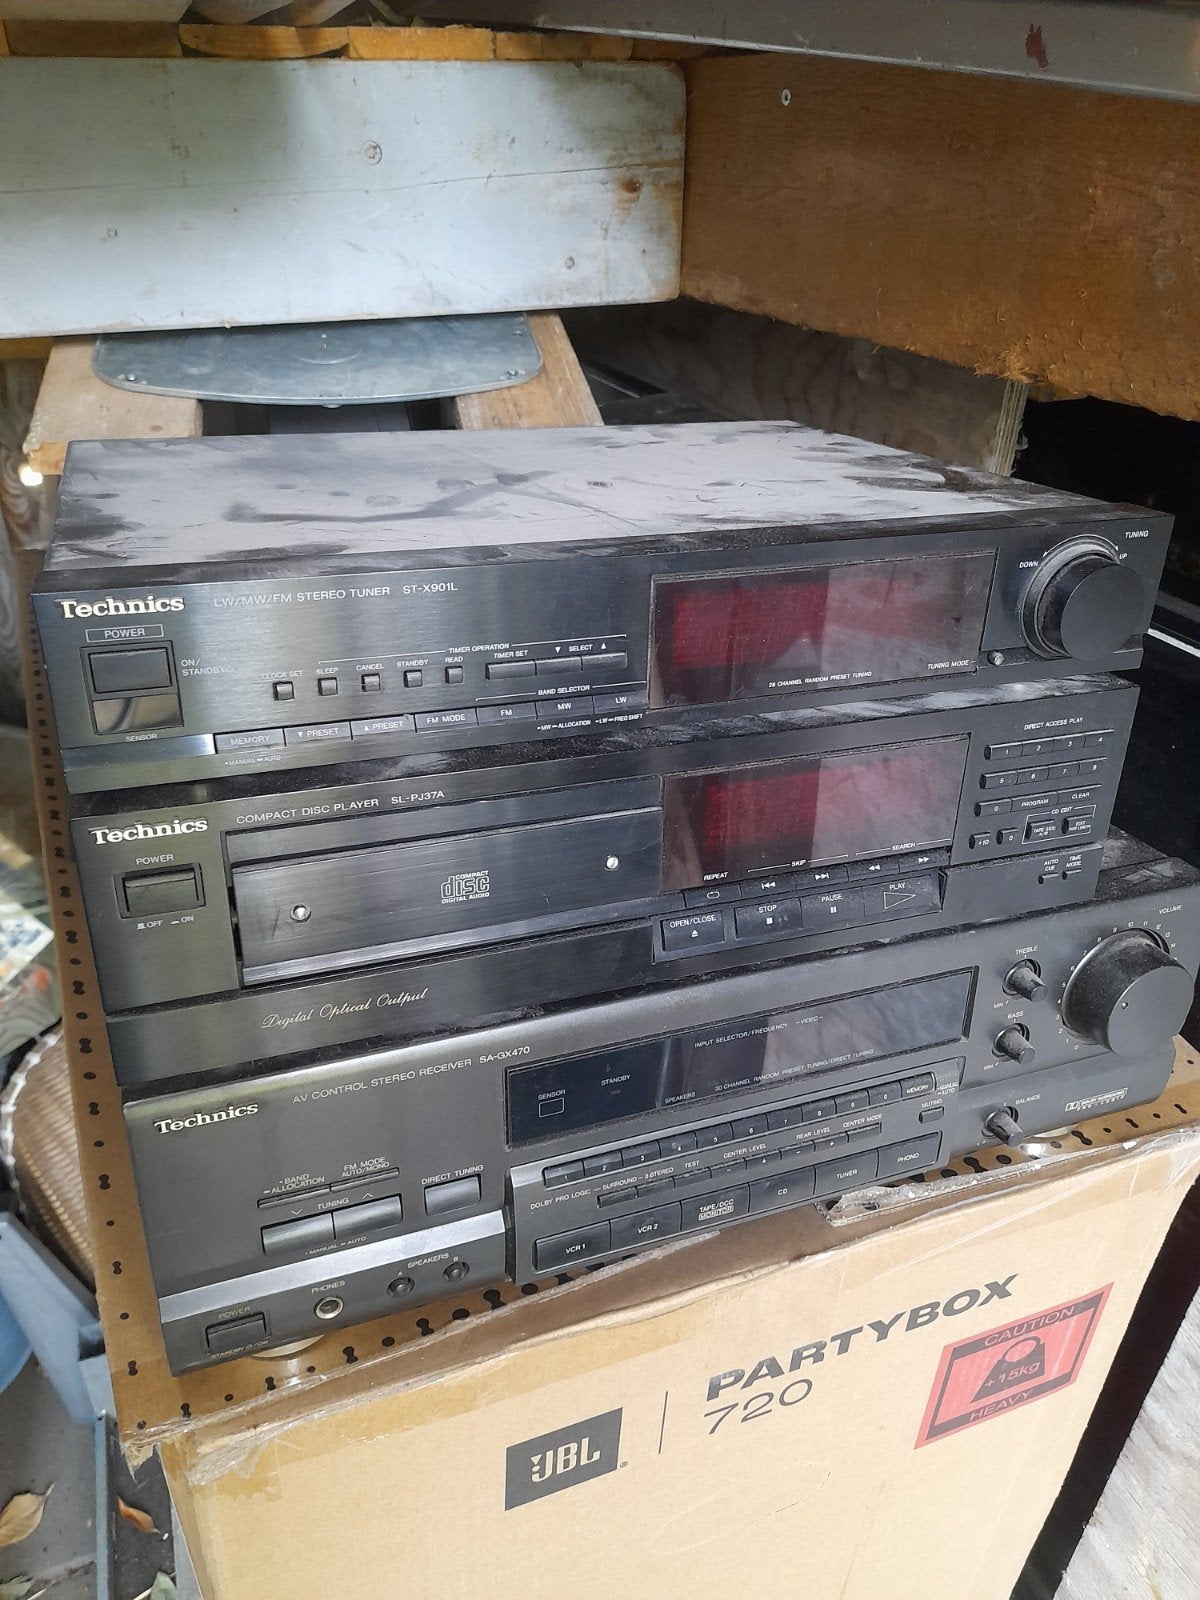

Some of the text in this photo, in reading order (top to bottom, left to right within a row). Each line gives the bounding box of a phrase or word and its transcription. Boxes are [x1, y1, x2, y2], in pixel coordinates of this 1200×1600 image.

[1125, 531, 1149, 539] TUNING
[1019, 561, 1039, 569] DOWN
[214, 583, 458, 607] LW/MW/FM STEREO TUNER ST-X901L
[61, 596, 184, 618] Technics
[104, 628, 146, 639] POWER
[449, 642, 509, 654] TIMER OPERATION
[569, 644, 593, 652] SELECT
[494, 651, 514, 659] TIMER
[181, 659, 200, 667] ON/
[356, 663, 384, 671] CANCEL
[397, 659, 429, 668] STANDBY
[927, 659, 970, 670] TUNING MODE
[262, 671, 288, 679] CLOCK
[777, 679, 803, 687] CHANNEL
[804, 676, 829, 684] RANDOM
[538, 685, 590, 695] BAND SELECTOR
[557, 702, 572, 711] MW
[426, 714, 466, 725] FM MODE
[1024, 722, 1044, 731] DIRECT
[1046, 719, 1067, 727] ACCESS
[373, 721, 403, 730] PRESET
[125, 733, 158, 742] SENSOR
[306, 727, 339, 738] PRESET
[230, 734, 270, 746] MEMORY
[1071, 791, 1090, 799] CLEAR
[236, 790, 445, 824] COMPACT DISC PLAYER SL-PJ37A
[1021, 798, 1049, 807] PROGRAM
[91, 817, 208, 845] Technics
[892, 842, 916, 851] SEARCH
[135, 854, 174, 865] POWER
[791, 859, 806, 867] SKIP
[1044, 858, 1059, 866] AUTO
[455, 870, 489, 880] COMPACT
[703, 871, 728, 881] REPEAT
[440, 875, 490, 899] disc
[889, 882, 906, 891] PLAY
[441, 892, 490, 905] DIGITAL AUDIO
[821, 893, 843, 902] PAUSE
[758, 904, 777, 914] STOP
[1159, 905, 1183, 914] VOLUME
[146, 919, 164, 928] OFF
[181, 915, 194, 924] ON
[669, 914, 716, 928] OPEN/CLOSE
[1015, 945, 1039, 955] TREBLE
[261, 987, 429, 1030] Digital Optical Output
[1007, 1011, 1024, 1020] BASS
[694, 1022, 788, 1048] INPUT SELECTOR/FREQUENCY
[292, 1046, 531, 1104] AV CONTROL STEREO RECEIVER SA-GX470
[723, 1079, 750, 1090] CHANNEL
[753, 1071, 779, 1082] RANDOM
[782, 1065, 804, 1075] PRESET
[807, 1055, 850, 1070] TUNING/DIRECT
[852, 1049, 874, 1058] TUNING
[601, 1074, 631, 1086] STANDBY
[537, 1089, 566, 1100] SENSOR
[906, 1084, 929, 1094] MEMORY
[664, 1091, 696, 1104] SPEAKERS
[1015, 1094, 1041, 1105] BALANCE
[921, 1099, 943, 1108] MUTING
[154, 1102, 259, 1134] Technics
[843, 1113, 883, 1128] CENTER MODE
[796, 1126, 831, 1140] REAR LEVEL
[723, 1143, 767, 1159] CENTER LEVEL
[897, 1152, 920, 1162] PHONO
[341, 1162, 390, 1177] AUTO/MONO
[344, 1157, 386, 1172] FM MODE
[684, 1160, 699, 1169] TEST
[421, 1164, 483, 1185] DIRECT TUNING
[836, 1169, 858, 1179] TUNER
[272, 1176, 325, 1194] ALLOCATION
[602, 1176, 638, 1190] SURROUND
[777, 1188, 788, 1196] CD
[317, 1197, 349, 1210] TUNING
[530, 1188, 591, 1210] DOLBY PRO LOGIC
[700, 1198, 734, 1213] TAPE/DCC
[699, 1206, 734, 1220] MONITOR
[637, 1224, 653, 1234] VCR
[565, 1244, 581, 1254] VCR
[407, 1253, 449, 1269] SPEAKERS
[311, 1280, 346, 1294] PHONES
[218, 1306, 251, 1319] POWER
[984, 1305, 1076, 1347] CAUTION
[706, 1273, 1019, 1402] PARTYBOX
[703, 1377, 814, 1436] 720
[969, 1389, 1034, 1421] HEAVY
[531, 1436, 601, 1484] JBL
